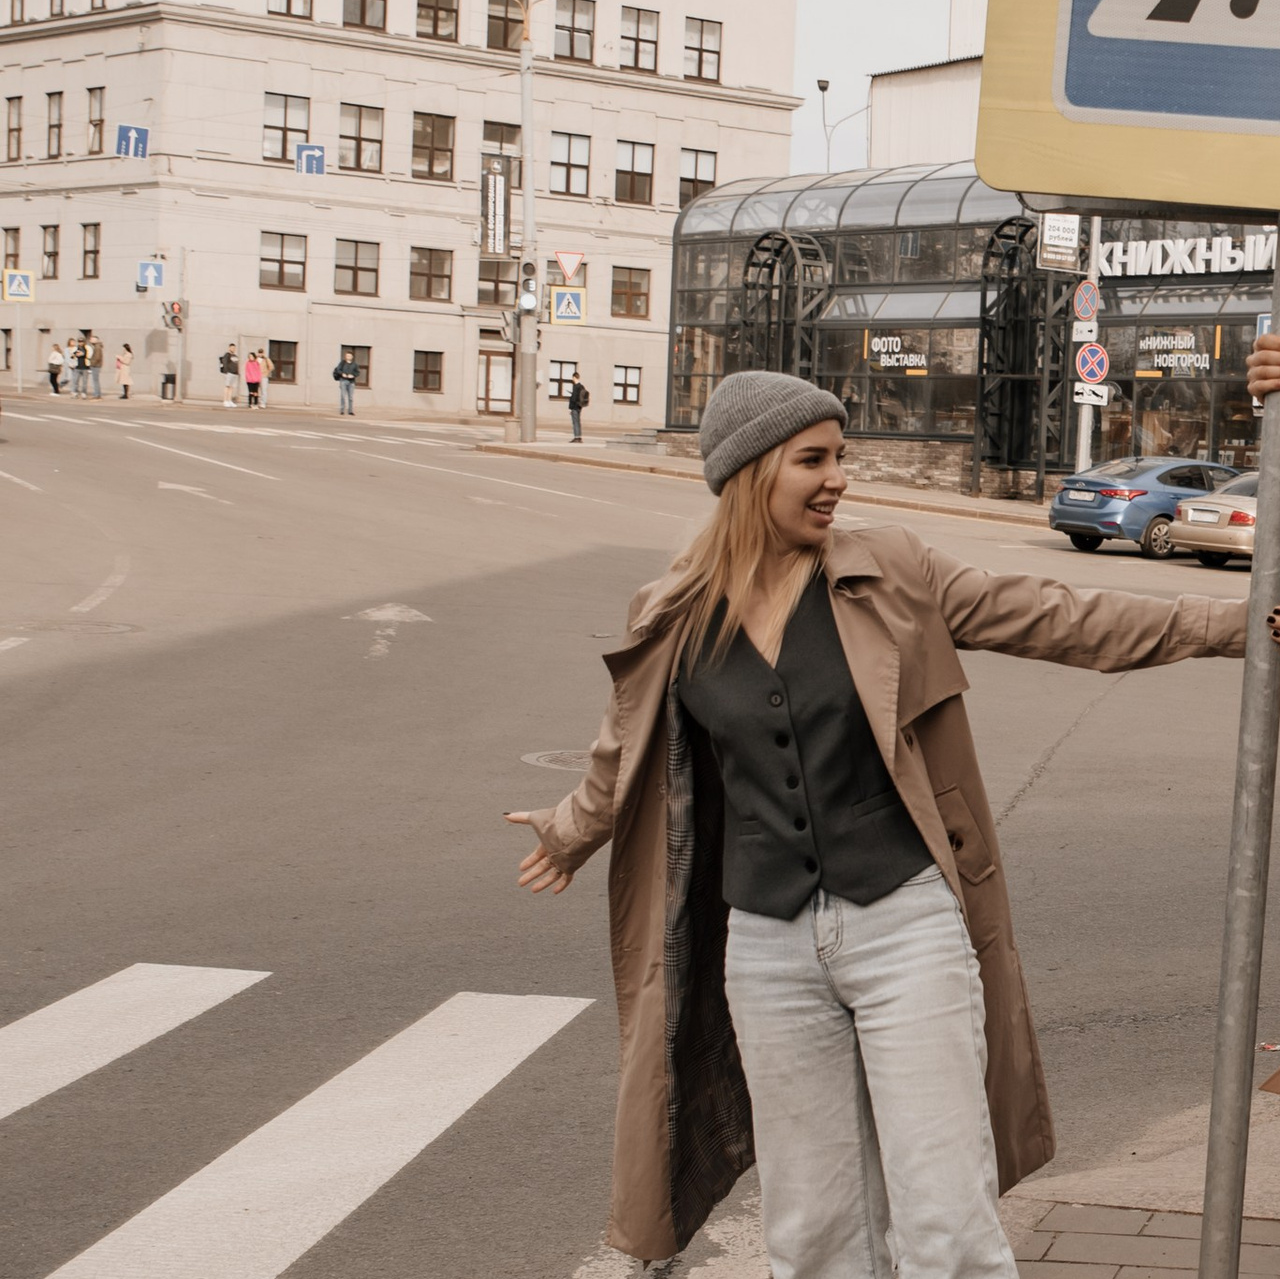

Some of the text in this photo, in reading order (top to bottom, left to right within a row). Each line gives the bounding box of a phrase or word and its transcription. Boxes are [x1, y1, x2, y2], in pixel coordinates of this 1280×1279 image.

[1062, 226, 1076, 235] 000
[871, 337, 901, 352] ФОТО
[880, 354, 927, 367] ВЫСТАВКА
[1154, 354, 1210, 370] НОВГОРОД
